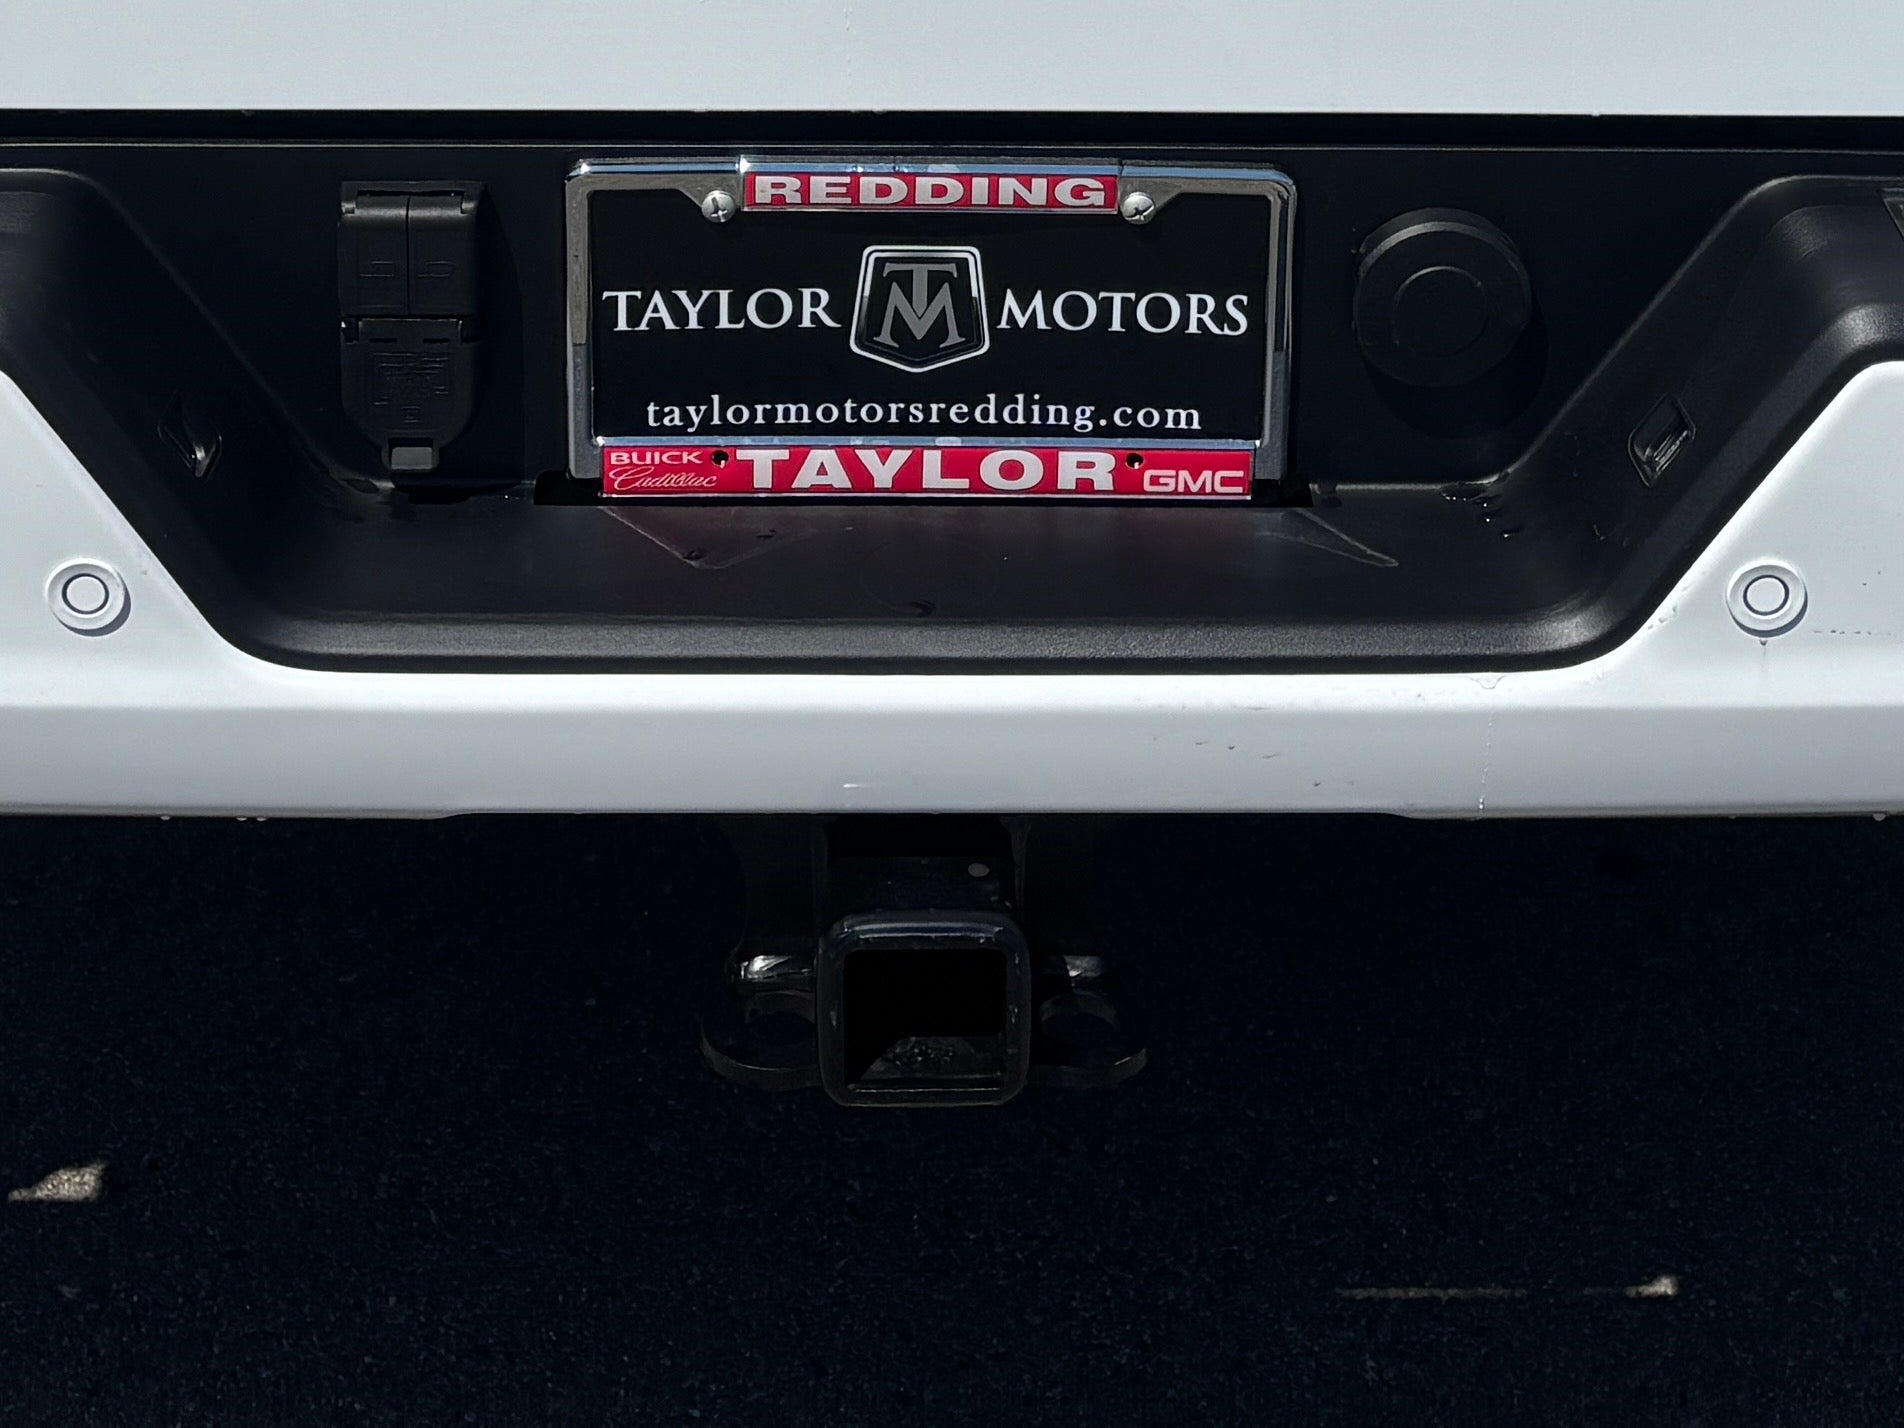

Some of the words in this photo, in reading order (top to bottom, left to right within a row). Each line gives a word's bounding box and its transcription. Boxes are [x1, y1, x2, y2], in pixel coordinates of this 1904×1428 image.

[754, 174, 1106, 207] REDDING
[601, 287, 842, 332] TAYLOR
[996, 288, 1249, 337] MOTORS
[646, 394, 1202, 433] taylormotorsredding.com
[608, 465, 718, 491] Cadillac
[609, 450, 703, 465] BUICK
[735, 448, 1116, 491] TAYLOR
[1142, 469, 1245, 494] GMC
